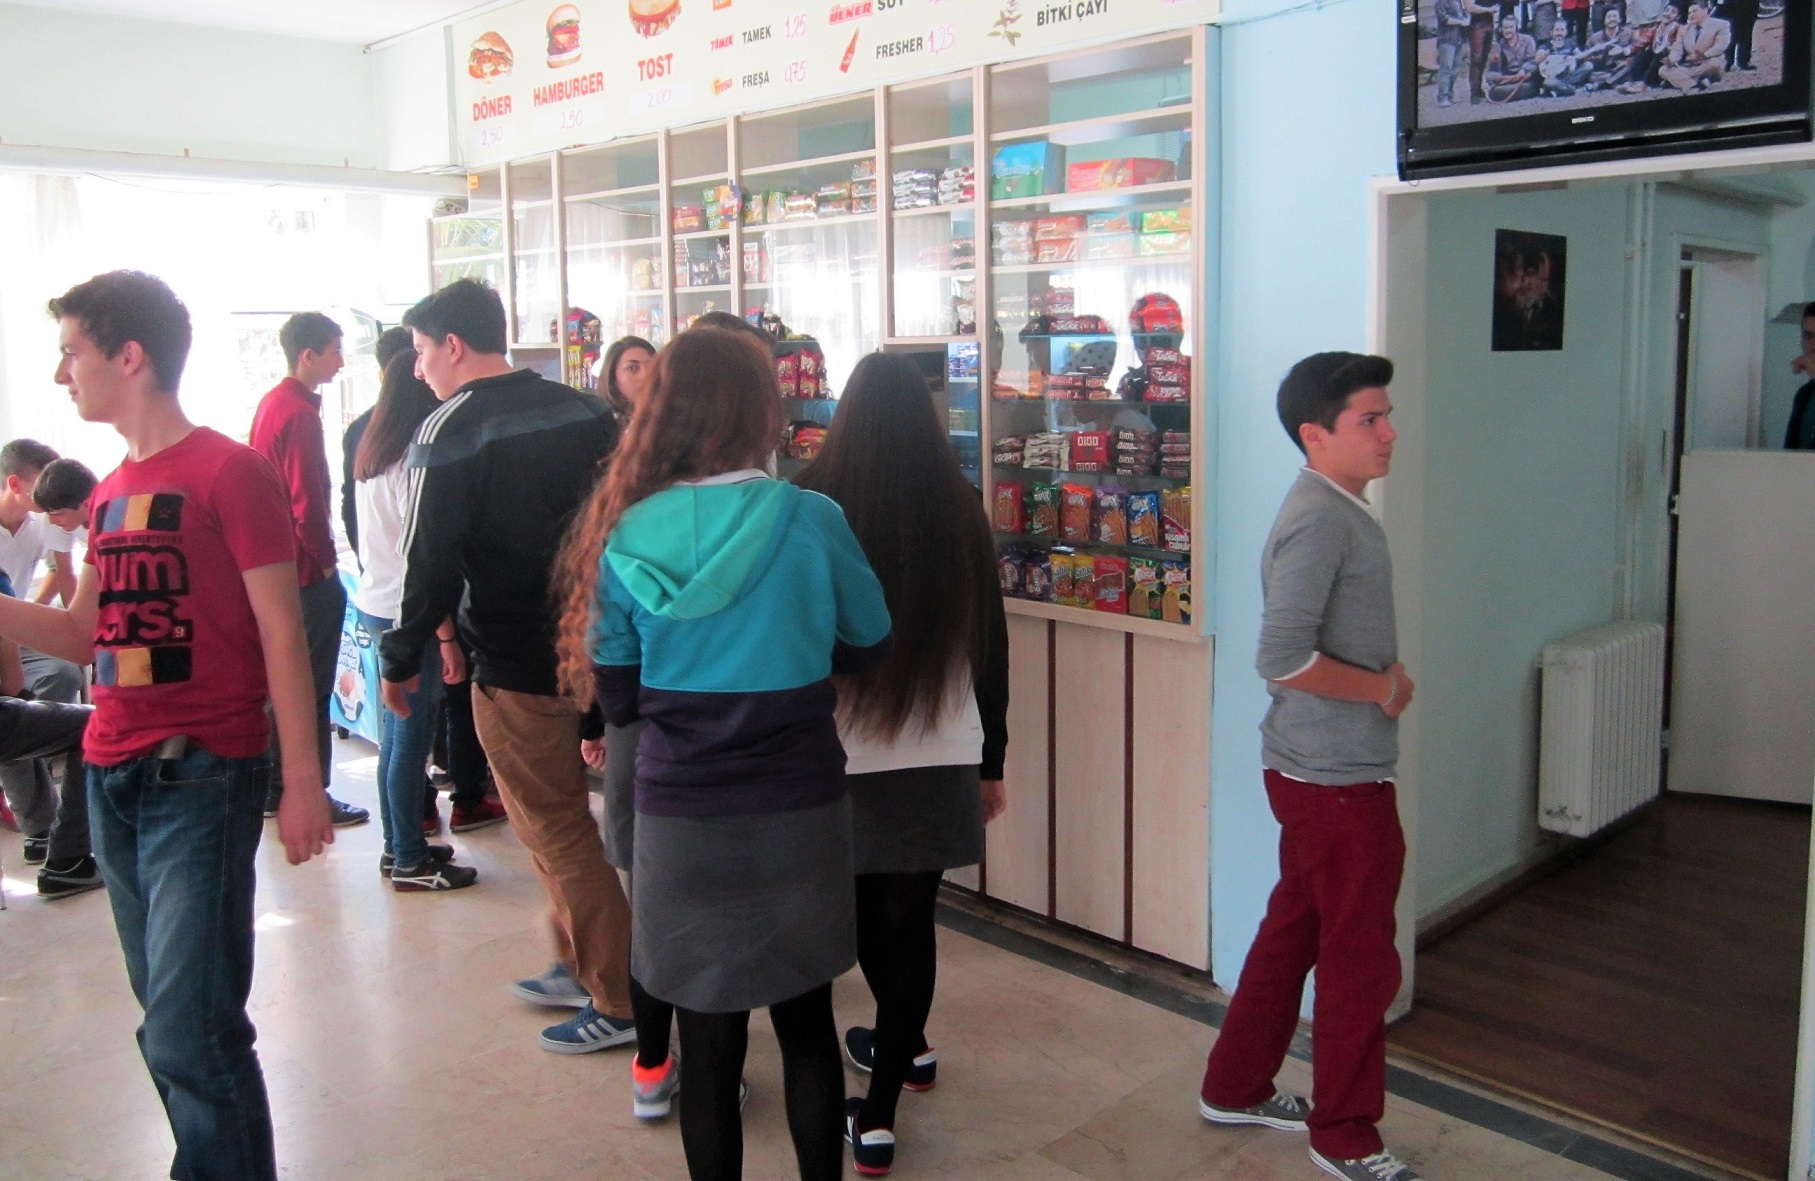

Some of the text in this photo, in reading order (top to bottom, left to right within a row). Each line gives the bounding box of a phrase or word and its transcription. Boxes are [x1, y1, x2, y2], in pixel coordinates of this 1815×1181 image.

[829, 2, 872, 23] ÜLKER
[1037, 0, 1072, 26] BİTKİ
[710, 35, 734, 51] TAMEK
[742, 25, 772, 44] TAMEK
[875, 36, 923, 60] FRESHER
[637, 52, 674, 81] TOST
[742, 70, 770, 88] FREŞA
[533, 71, 604, 107] HAMBURGER
[472, 95, 513, 122] DÖNER
